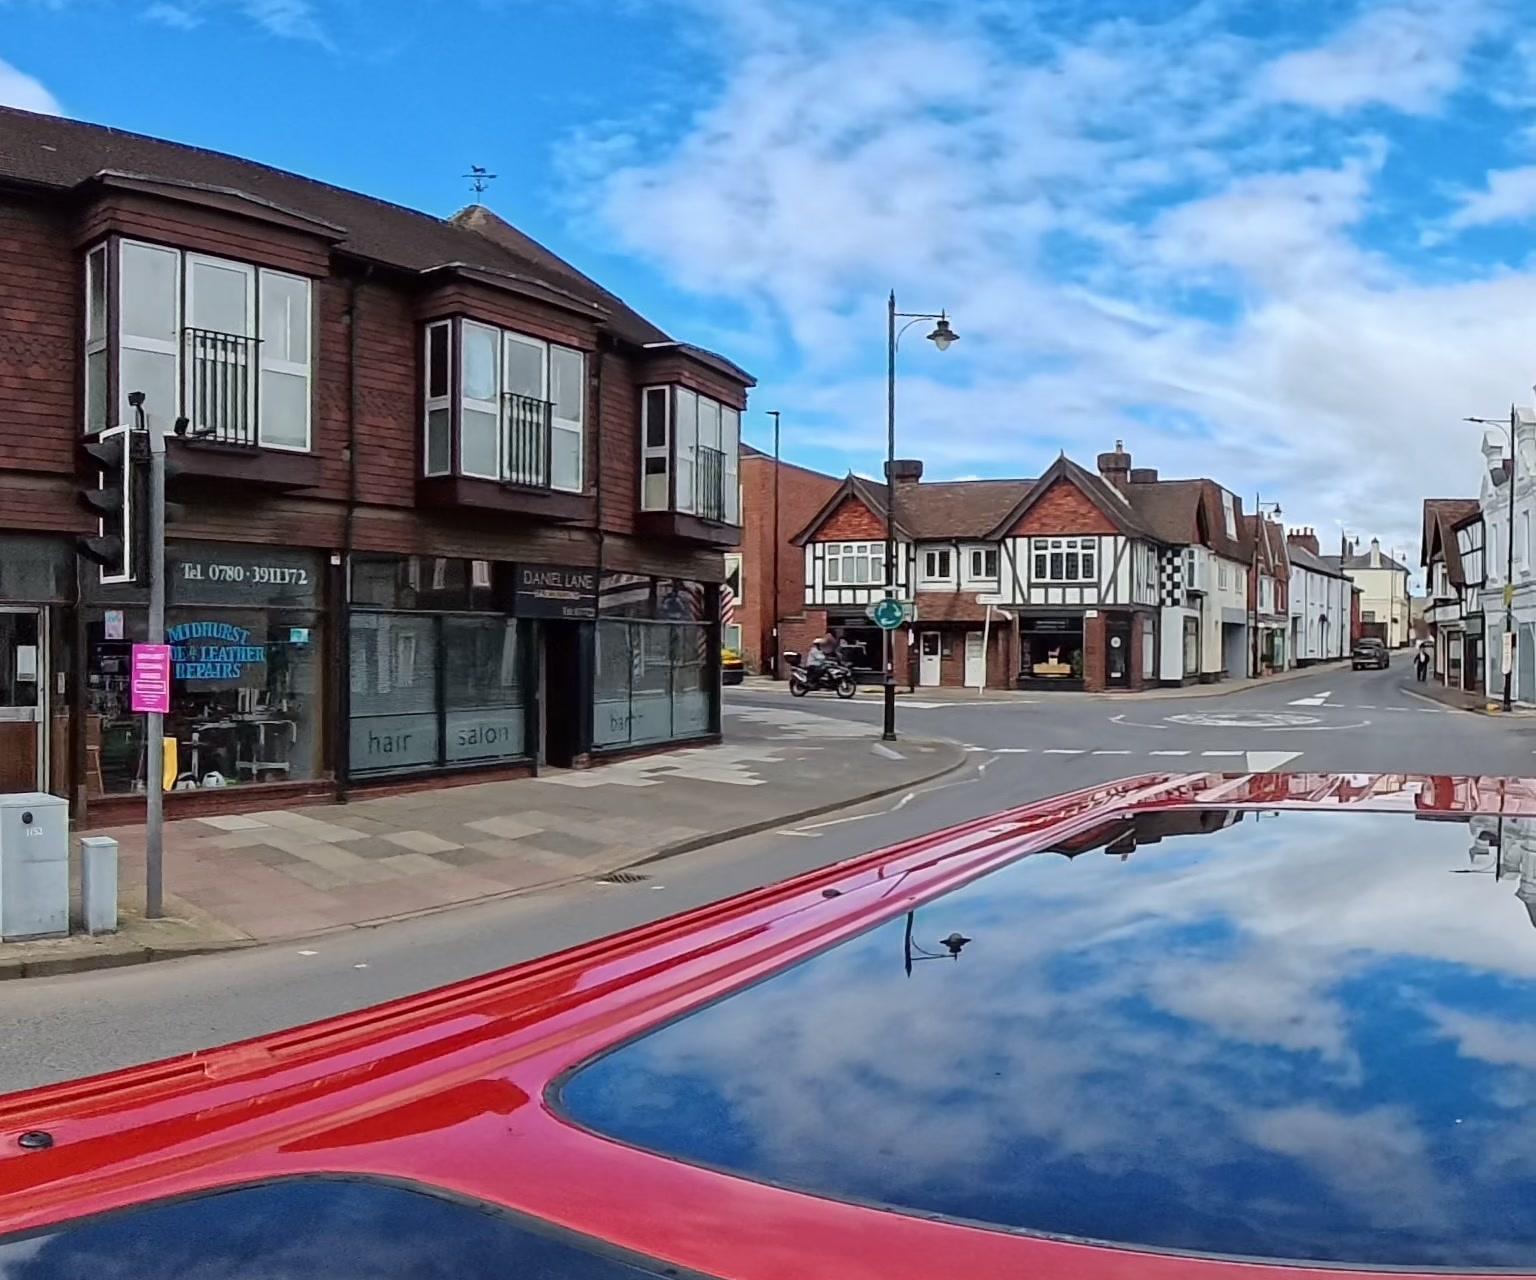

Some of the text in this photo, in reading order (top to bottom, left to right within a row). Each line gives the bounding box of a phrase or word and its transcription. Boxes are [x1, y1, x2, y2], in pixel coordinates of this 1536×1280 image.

[523, 570, 594, 590] DANIEL LANE
[167, 622, 251, 645] MIDHURST
[200, 646, 265, 662] LEATHER
[175, 662, 241, 679] REPAIRS
[368, 726, 509, 754] hair salon
